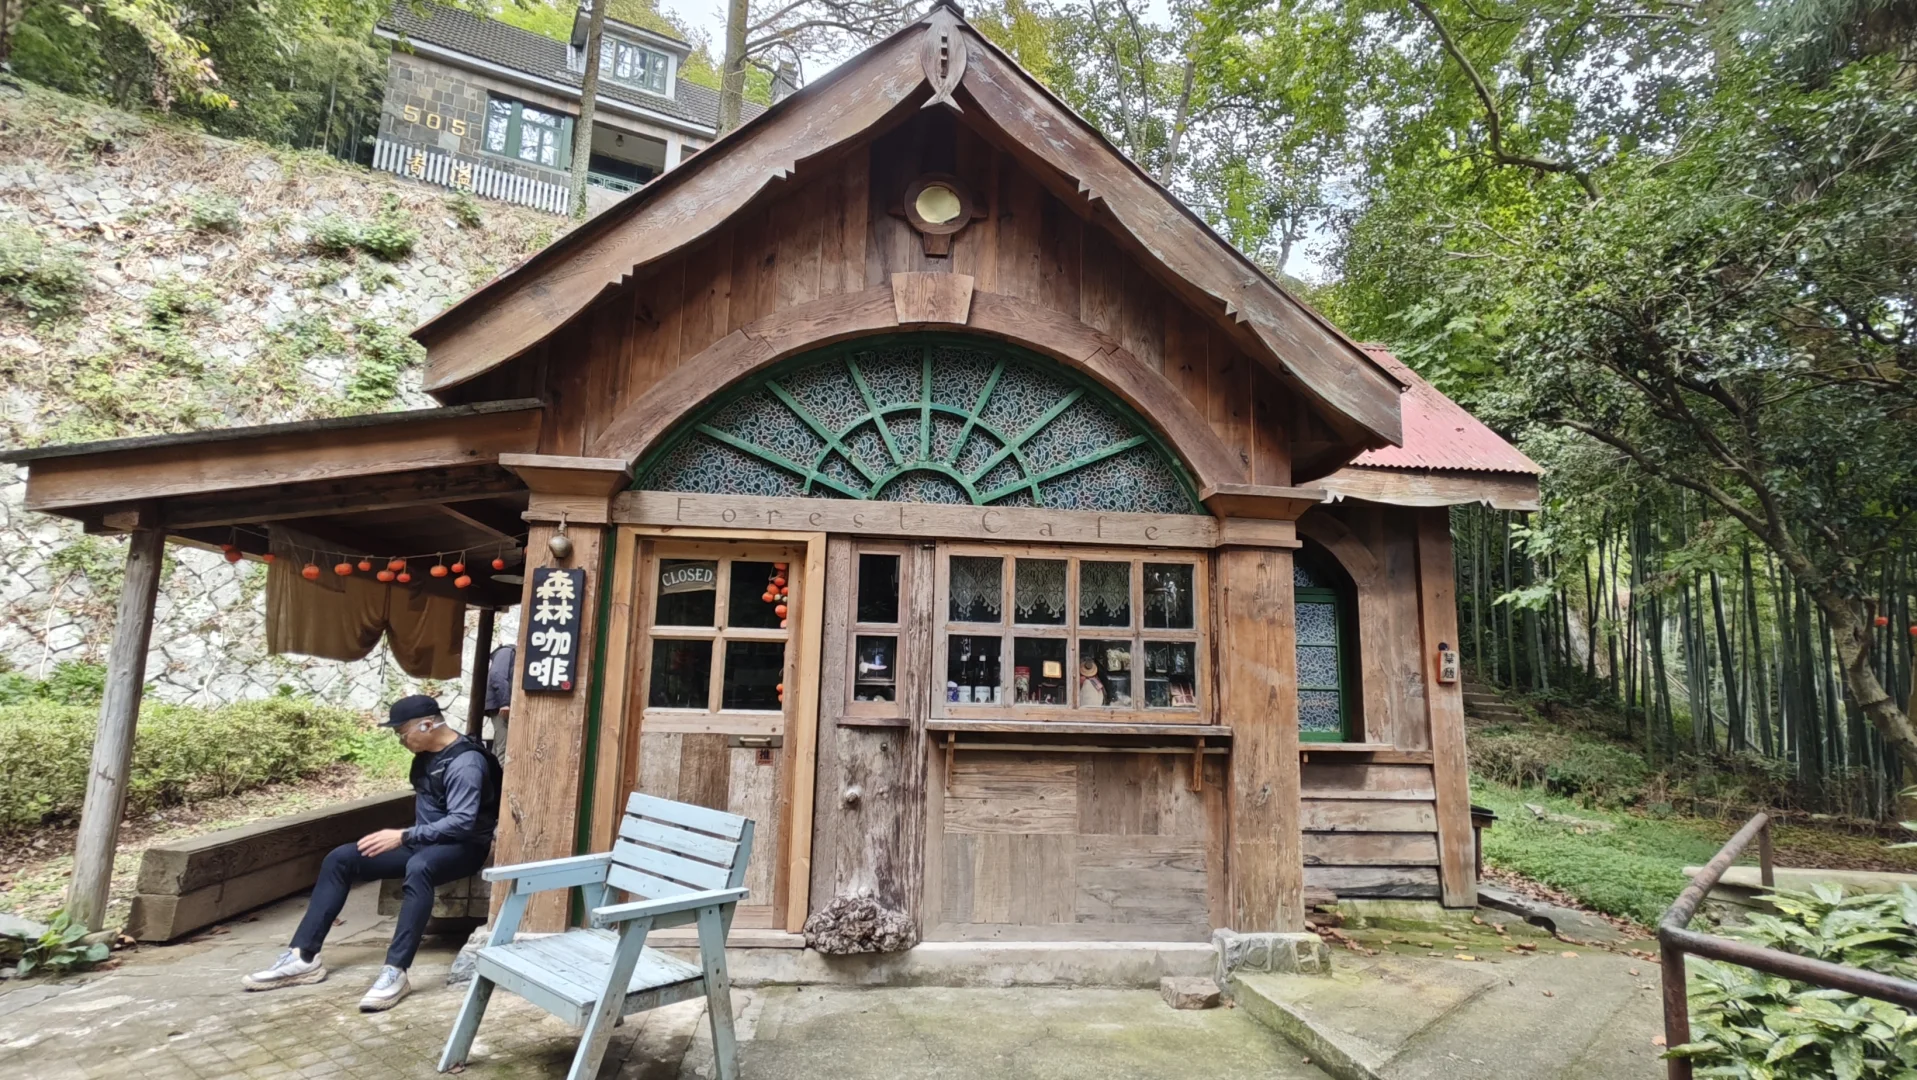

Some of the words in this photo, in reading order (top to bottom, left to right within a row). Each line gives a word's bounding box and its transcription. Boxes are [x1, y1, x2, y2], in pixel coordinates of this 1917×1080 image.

[403, 104, 467, 136] 505
[676, 497, 910, 531] Forest
[981, 510, 1160, 541] Cafe
[661, 567, 713, 587] CLOSED
[528, 570, 576, 687] 森林咖啡
